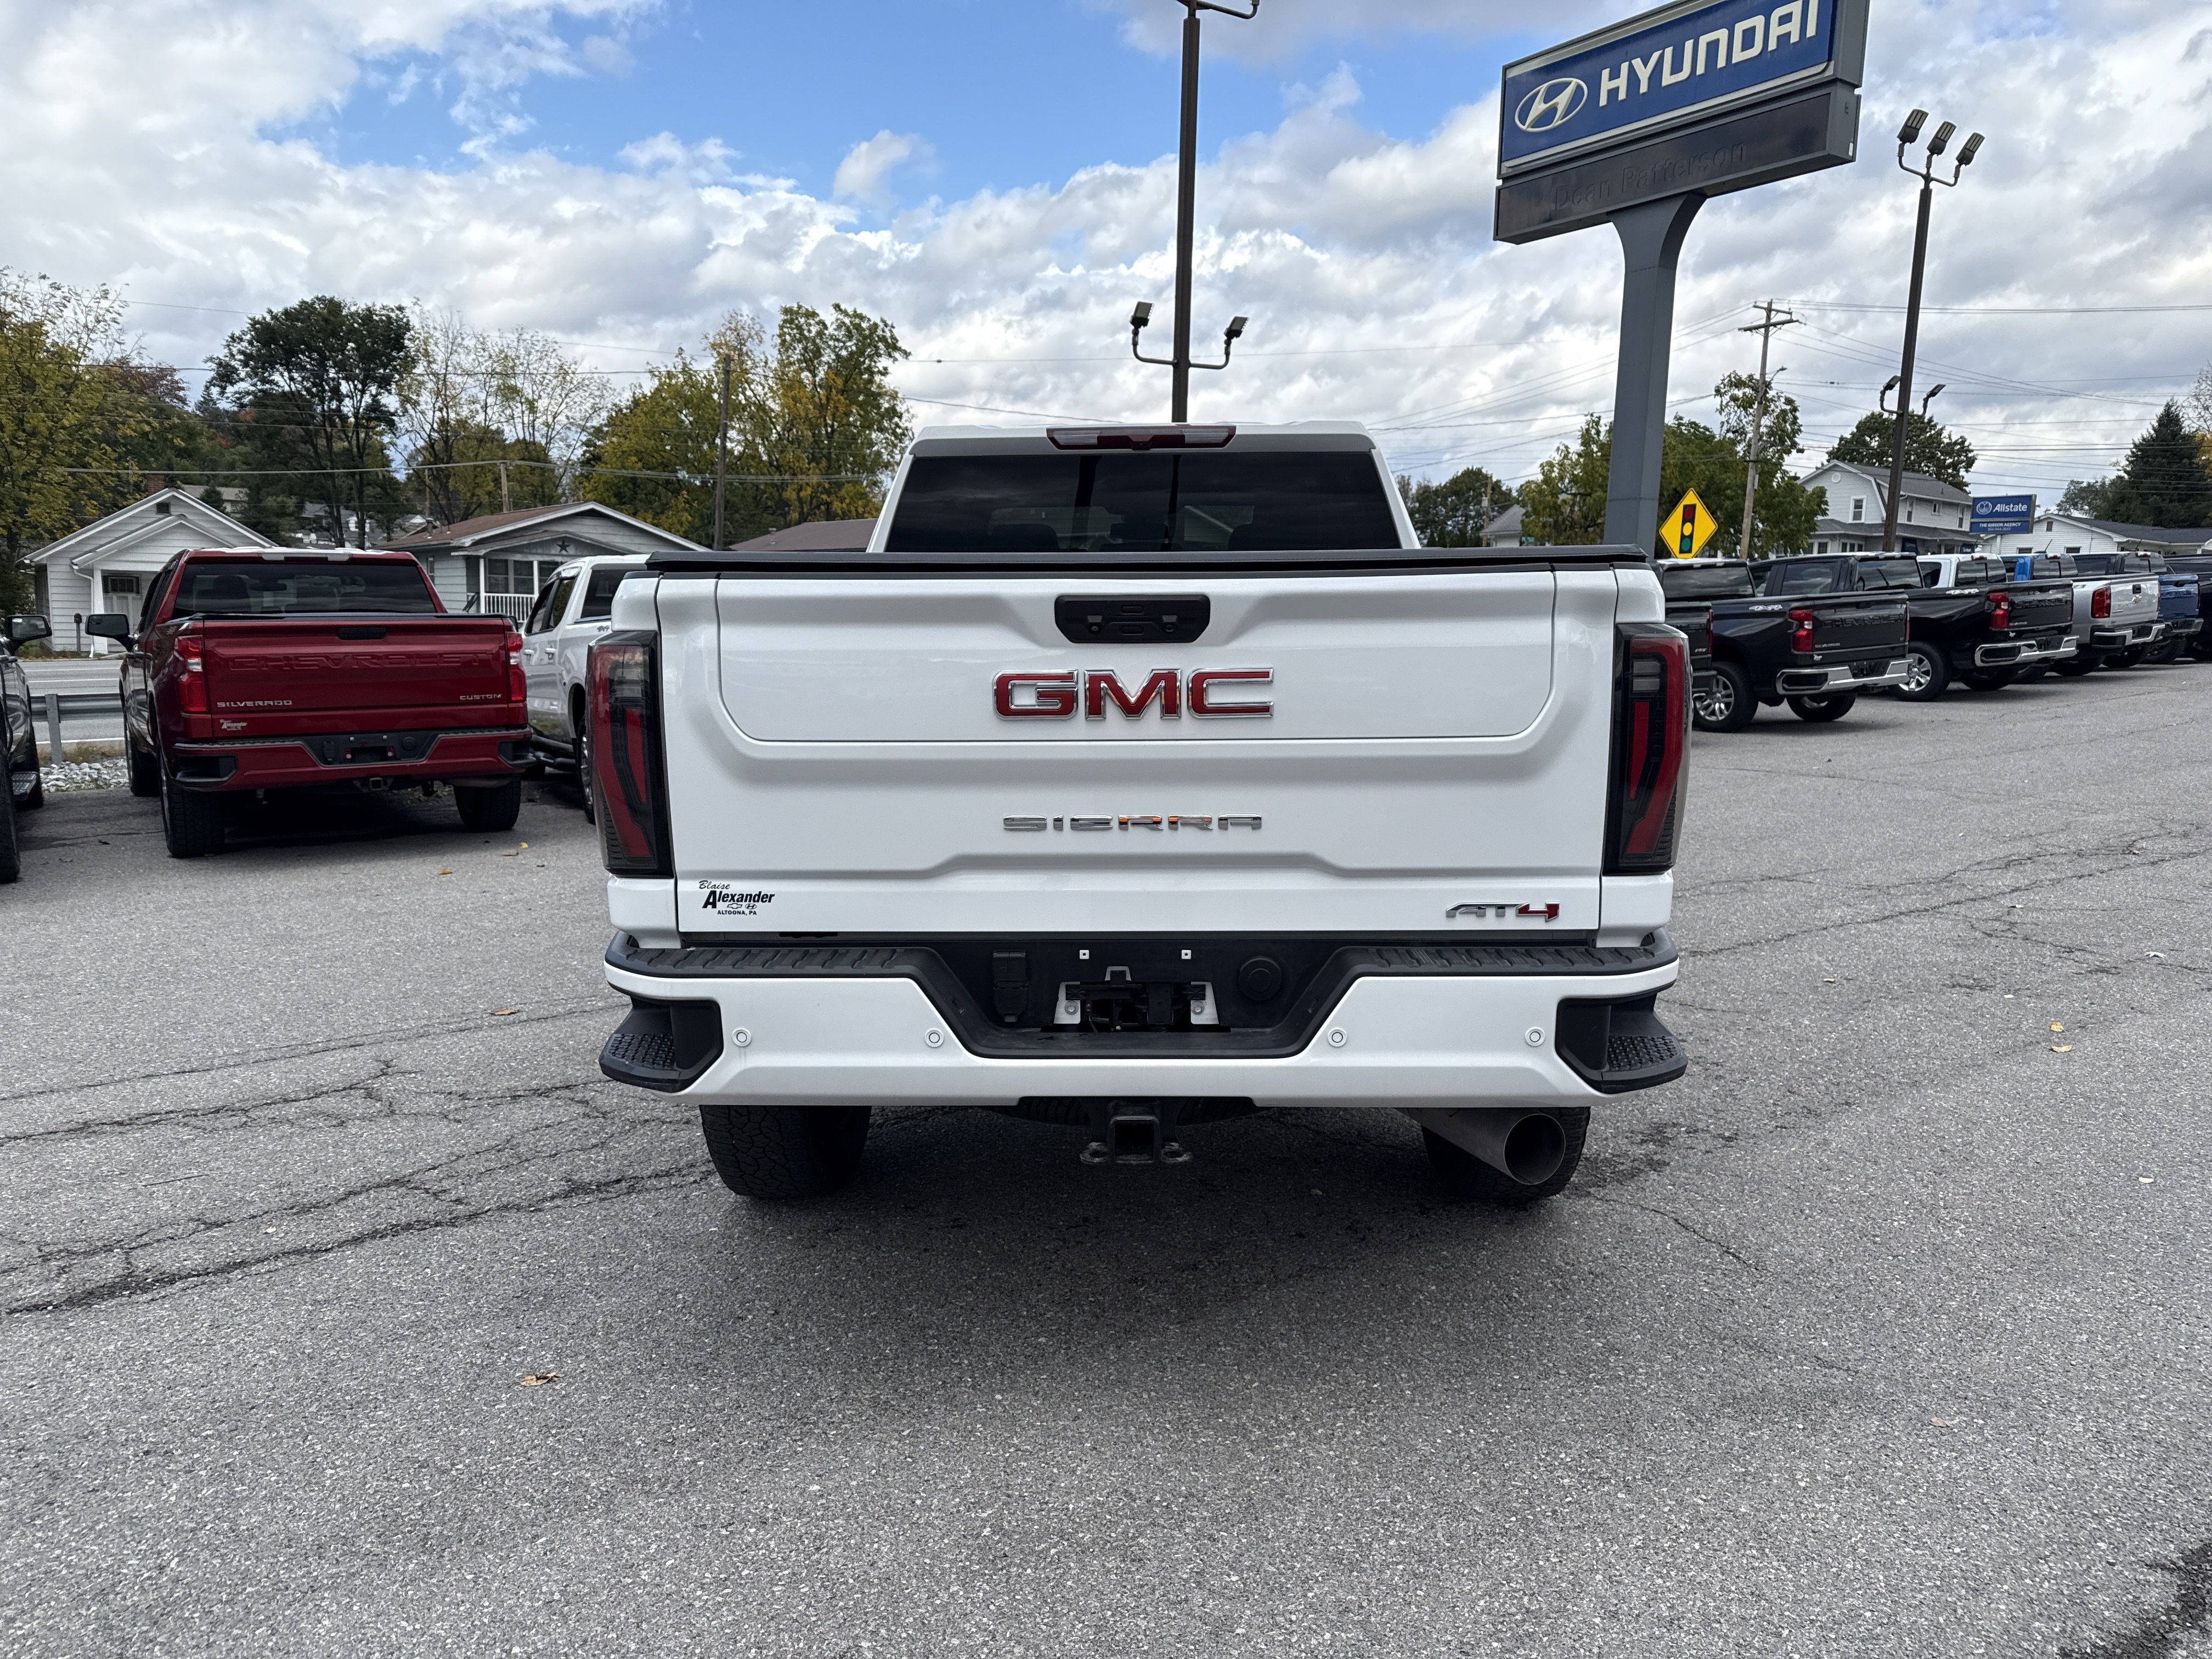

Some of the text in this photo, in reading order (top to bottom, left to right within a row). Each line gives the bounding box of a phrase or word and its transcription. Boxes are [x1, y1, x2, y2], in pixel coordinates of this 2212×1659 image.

[1599, 0, 1819, 107] HYUNDAI
[1555, 142, 1746, 211] Dean Patterson
[1993, 503, 2028, 512] Allstate
[229, 653, 495, 671] CHEVROLET
[992, 668, 1274, 720] GMC
[1003, 814, 1263, 831] SIERRA
[698, 880, 731, 890] Blaise
[702, 890, 775, 909] Alexander
[1446, 902, 1560, 922] AT4
